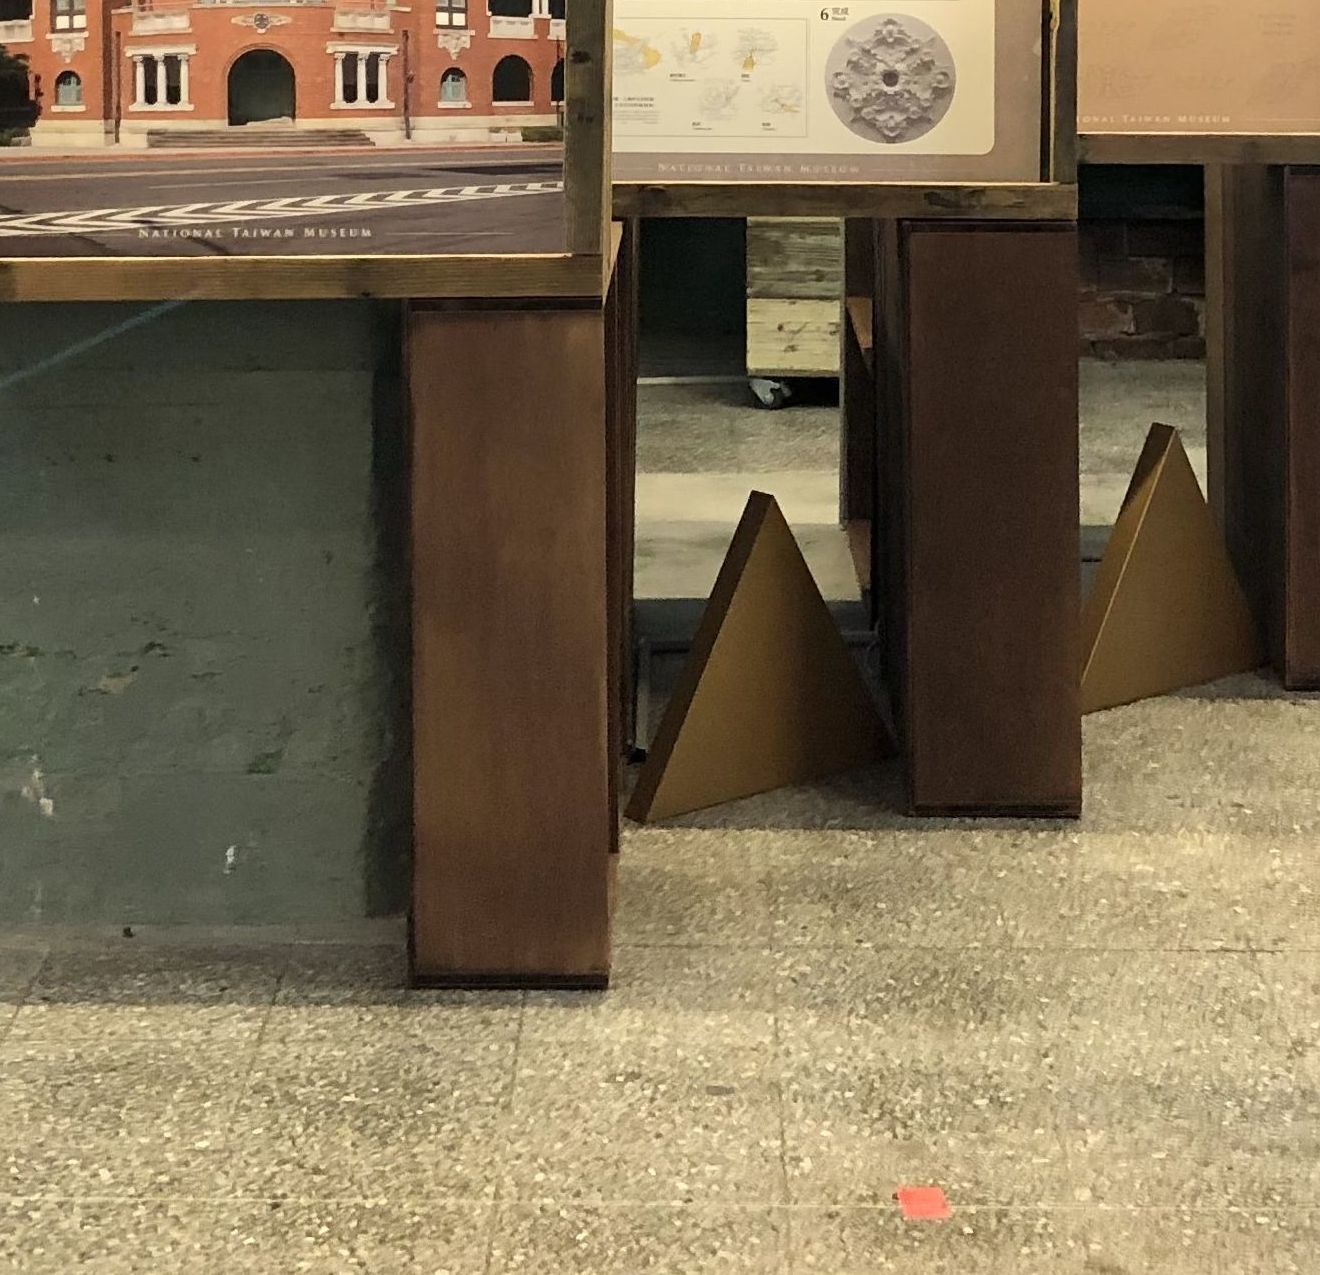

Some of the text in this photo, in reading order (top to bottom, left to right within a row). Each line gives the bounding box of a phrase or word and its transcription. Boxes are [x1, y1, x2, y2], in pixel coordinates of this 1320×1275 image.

[820, 7, 829, 21] 6
[137, 226, 373, 239] NATIONAL TAIWAN MUSEUM
